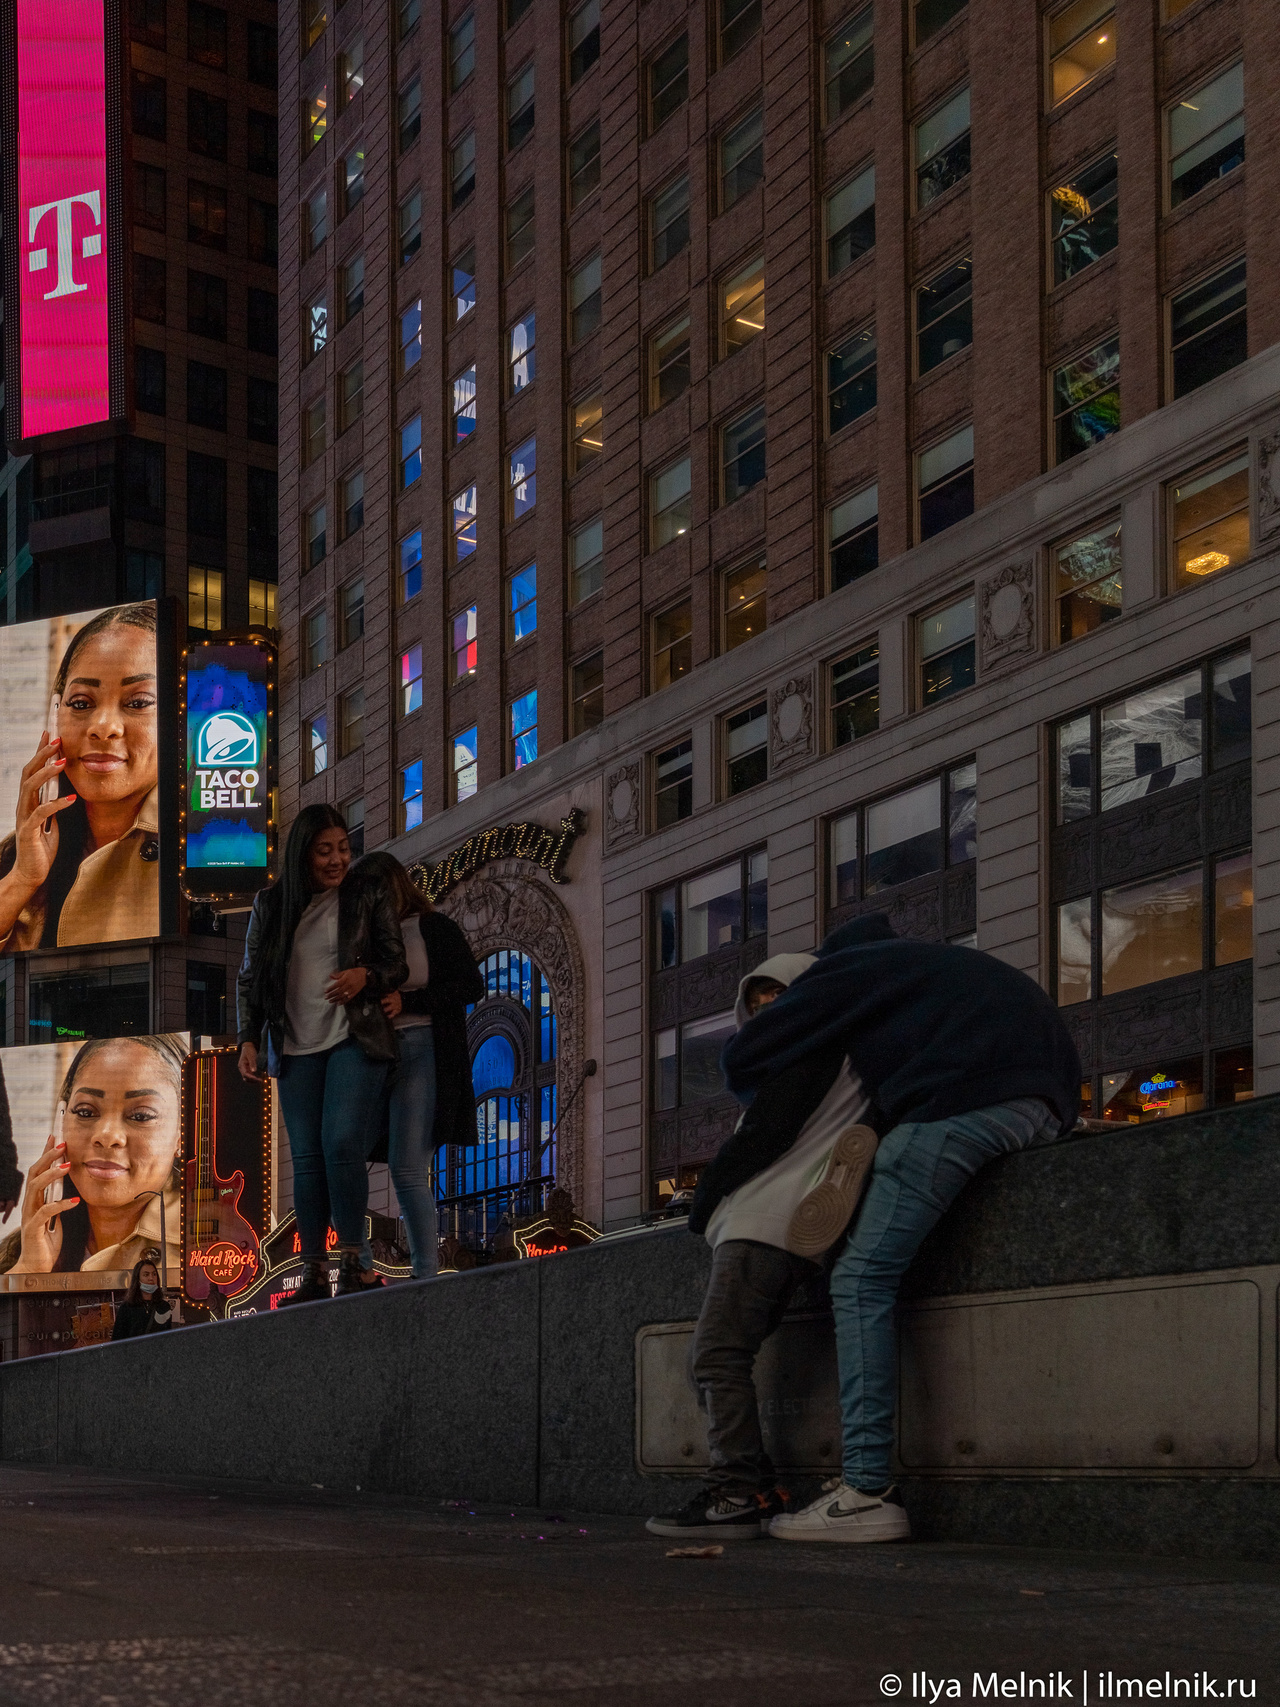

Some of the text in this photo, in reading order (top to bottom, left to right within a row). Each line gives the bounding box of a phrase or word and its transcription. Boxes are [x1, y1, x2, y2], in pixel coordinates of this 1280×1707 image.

[195, 769, 260, 790] TACO
[1140, 1080, 1177, 1094] Corona
[189, 1249, 257, 1269] Hard Rock
[213, 1269, 233, 1277] CAFE
[282, 1276, 295, 1290] STAY
